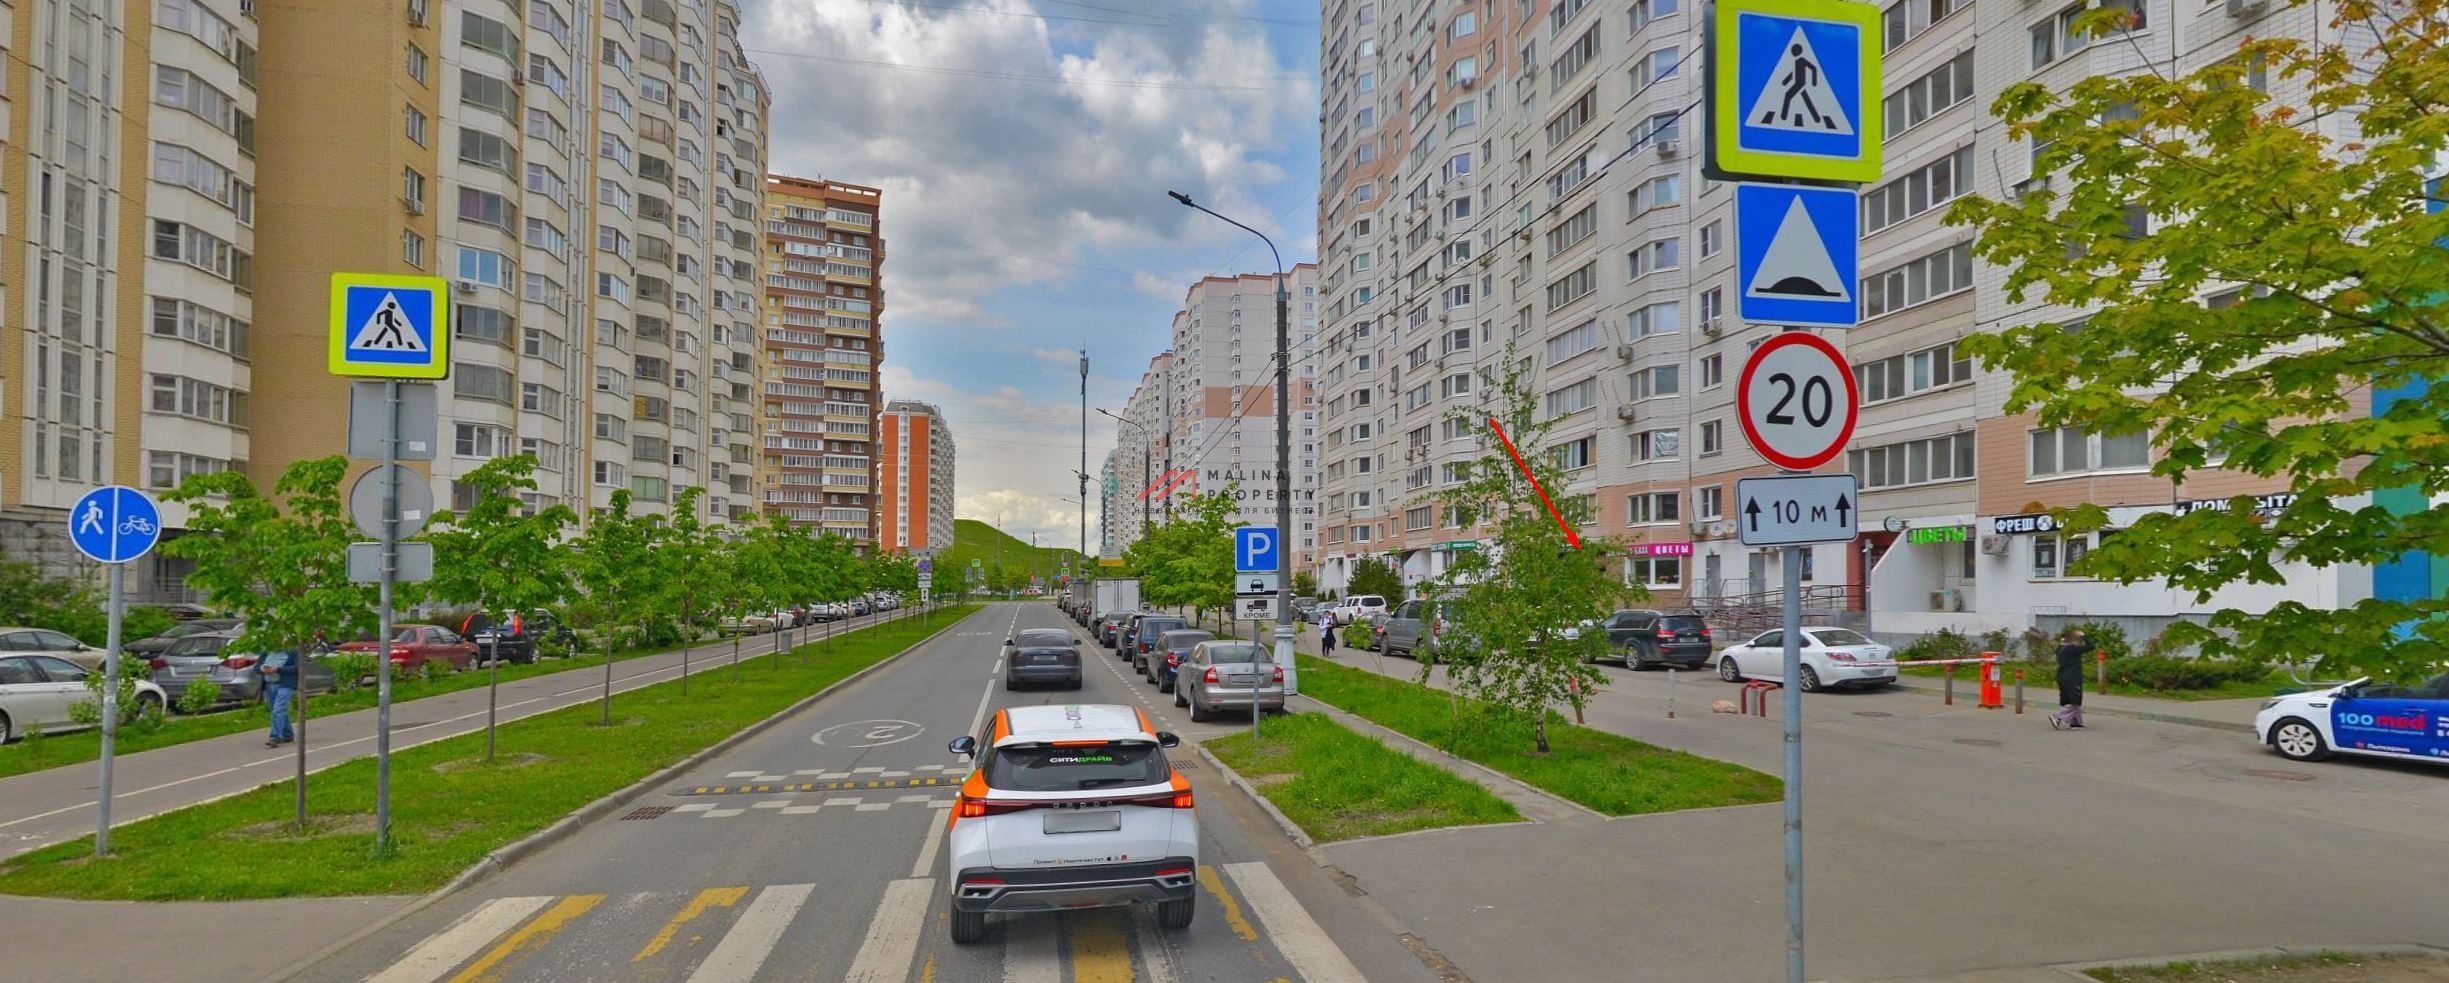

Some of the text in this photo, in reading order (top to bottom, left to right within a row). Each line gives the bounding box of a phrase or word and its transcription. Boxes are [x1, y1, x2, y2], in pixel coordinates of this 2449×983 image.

[1766, 373, 1833, 428] 20
[1772, 499, 1800, 524] 10
[1910, 526, 1966, 544] ЦВЕТЫ
[1995, 518, 2035, 533] ФРЕШ
[1247, 532, 1271, 567] P
[1655, 545, 1689, 555] ЦВЕТЫ
